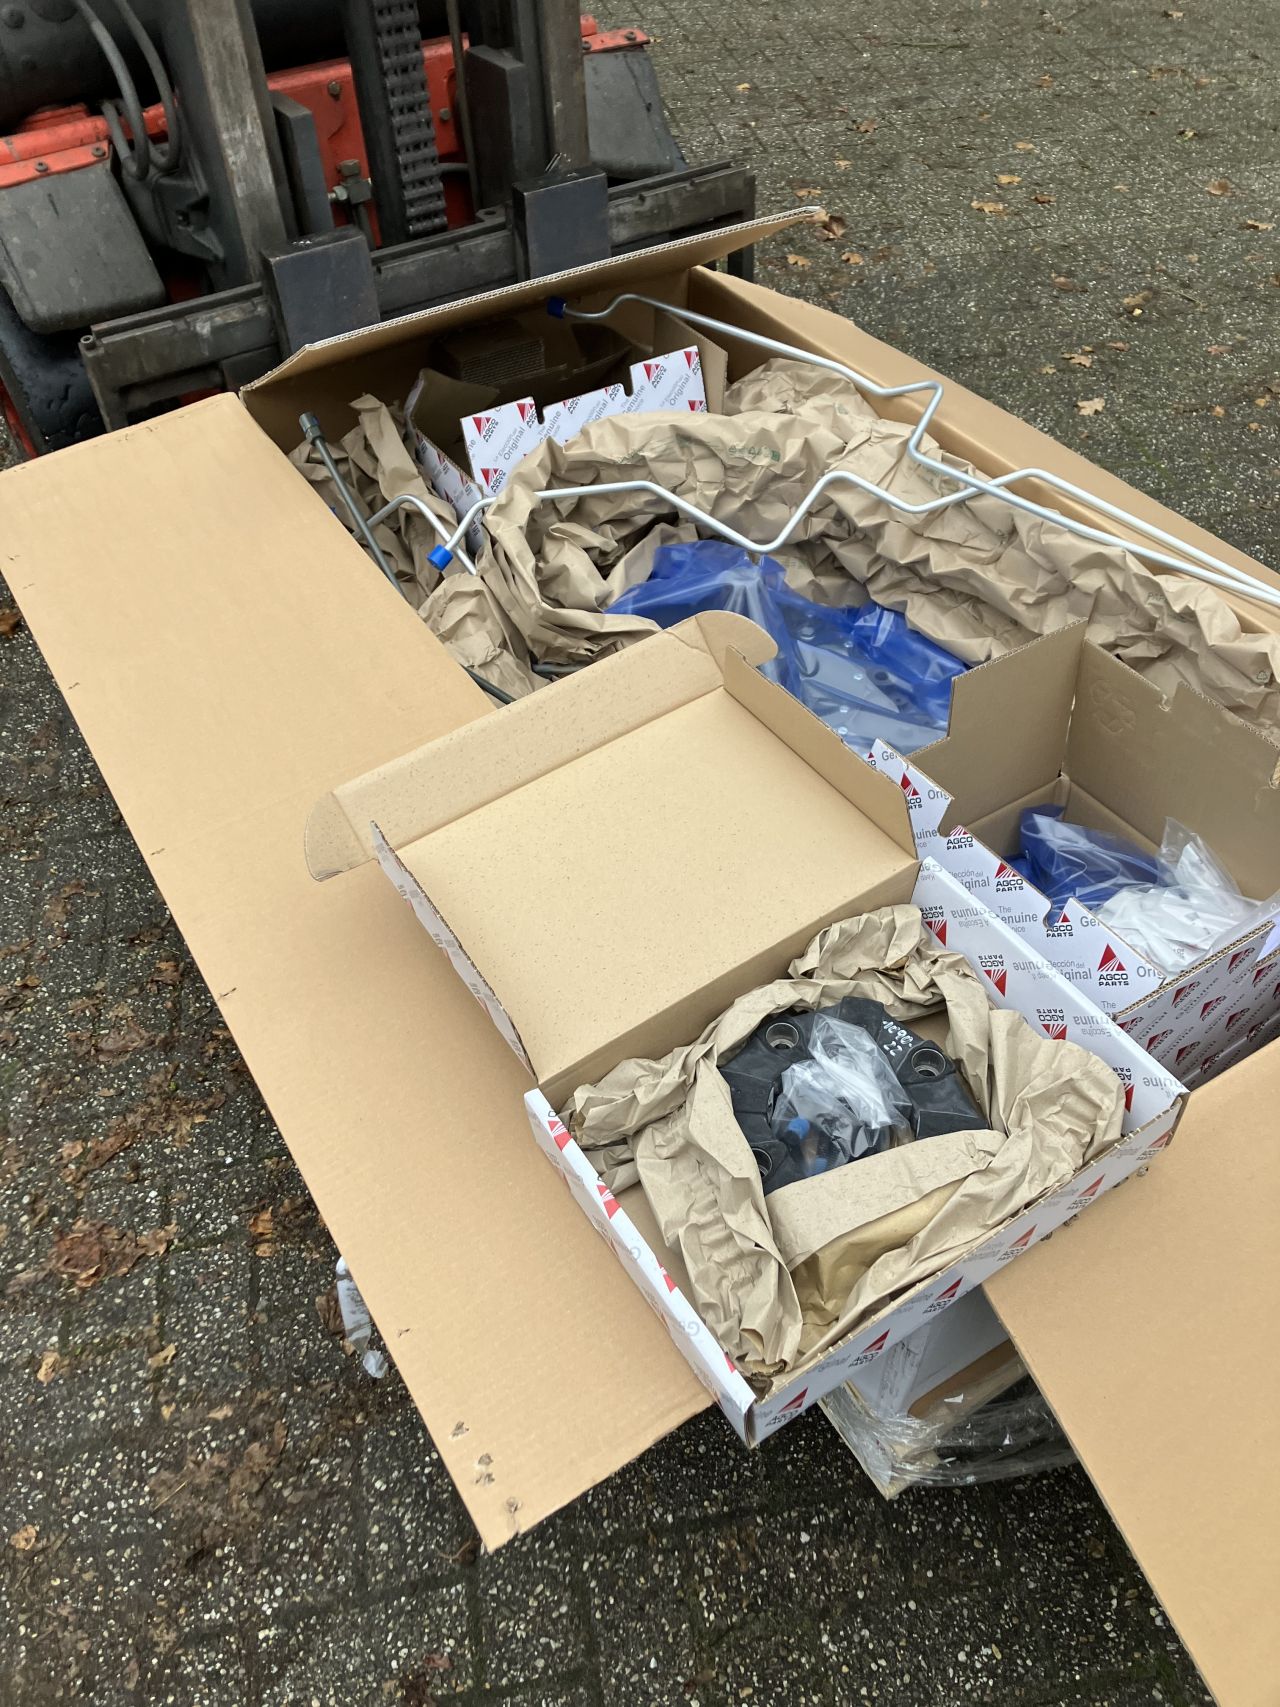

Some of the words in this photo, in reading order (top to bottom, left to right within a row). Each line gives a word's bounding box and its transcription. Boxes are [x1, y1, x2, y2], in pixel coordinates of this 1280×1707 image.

[668, 373, 691, 406] Original
[482, 418, 495, 439] AGCO
[502, 426, 526, 461] Original
[489, 468, 503, 490] AGCO
[916, 828, 938, 840] uine
[946, 836, 973, 846] AGCO
[996, 879, 1024, 887] AGCO
[922, 911, 944, 919] AGCO
[1000, 912, 1038, 924] enuine
[1101, 1000, 1116, 1008] The
